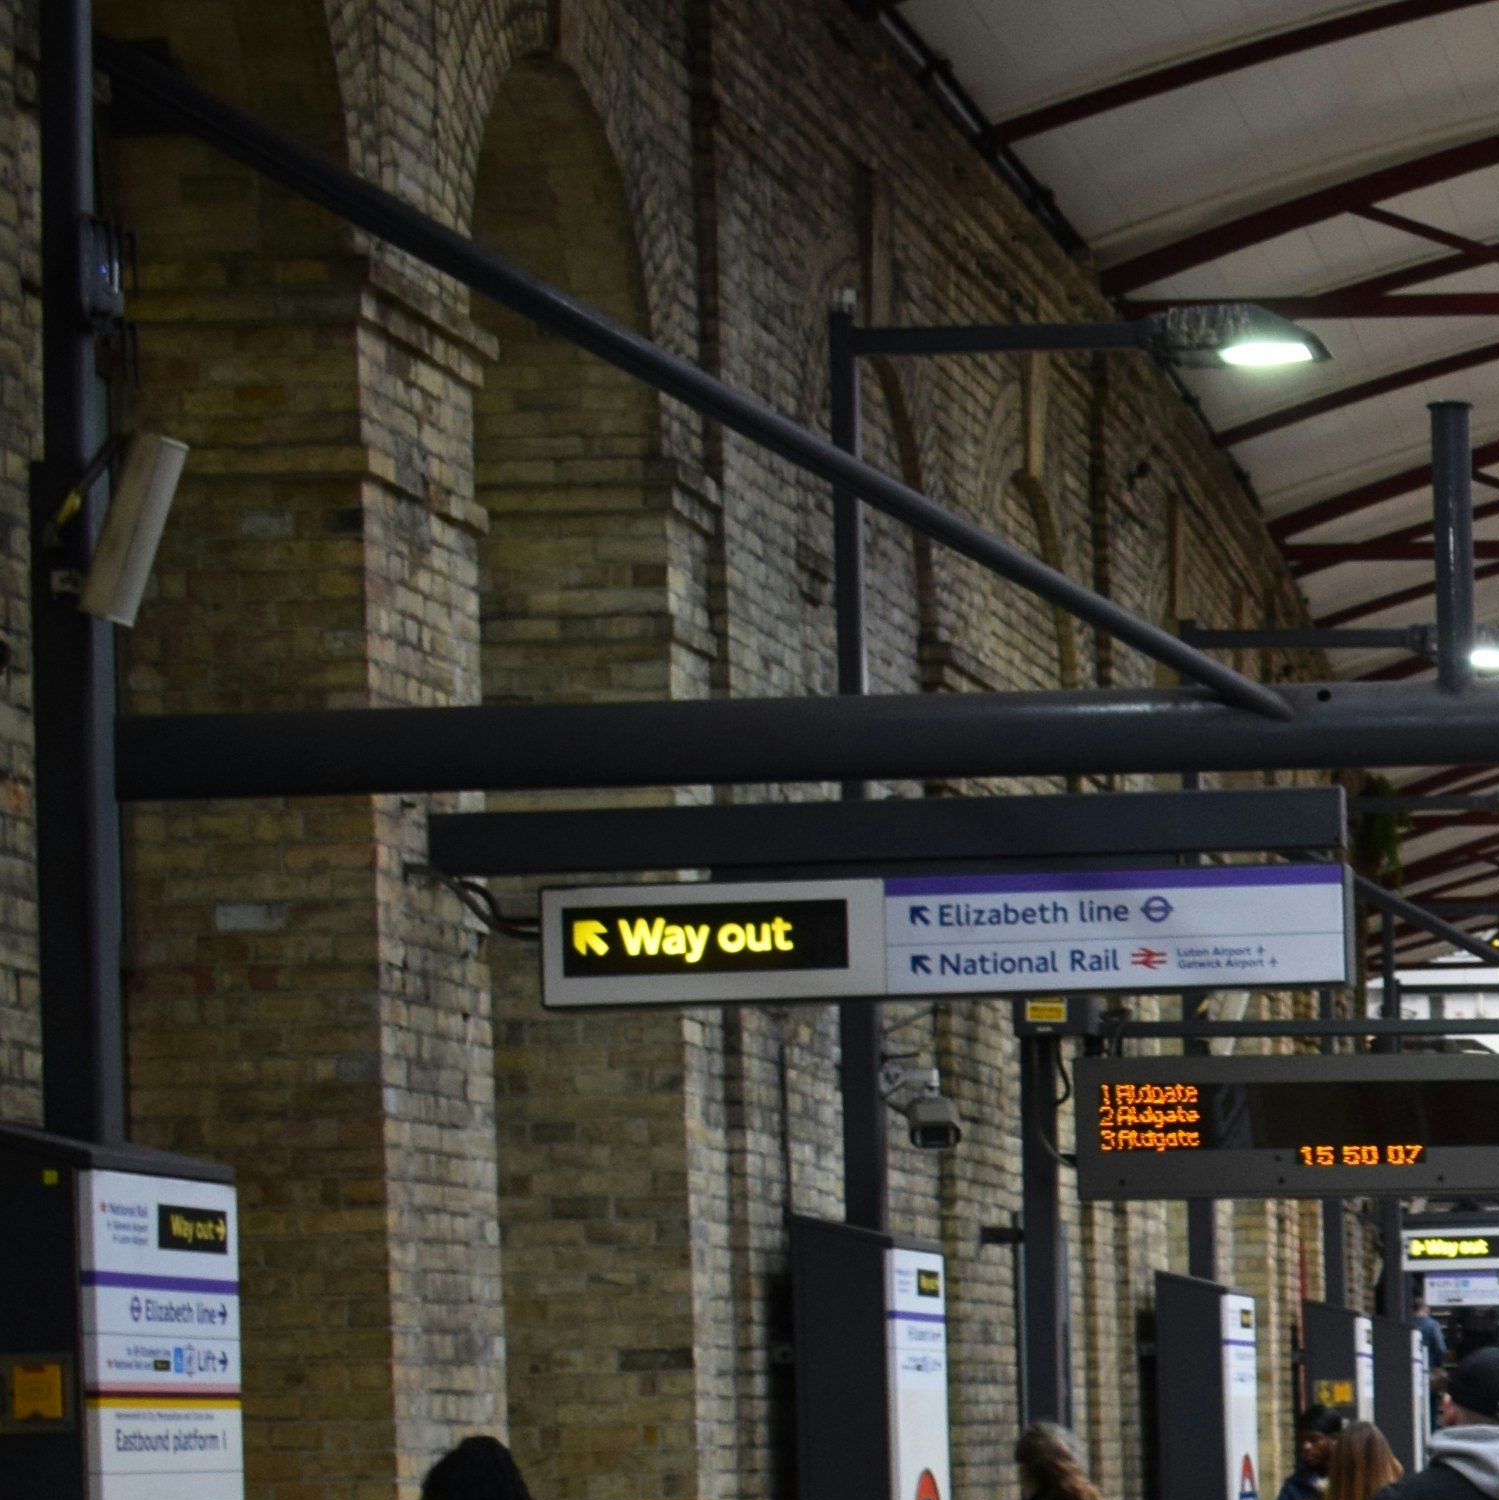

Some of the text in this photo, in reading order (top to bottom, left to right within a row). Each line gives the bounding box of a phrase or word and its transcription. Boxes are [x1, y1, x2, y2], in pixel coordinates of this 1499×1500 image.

[939, 898, 1130, 928] Elizabeth line
[618, 917, 794, 963] Way out
[1212, 946, 1252, 956] Airport
[940, 949, 1120, 976] National Rail
[1178, 958, 1264, 969] Gatwick Airport
[1101, 1083, 1198, 1105] 1 Aldgate
[1099, 1106, 1114, 1126] 2
[1116, 1105, 1200, 1129] Aldgate
[1100, 1130, 1116, 1151] 3
[1118, 1129, 1200, 1152] Aldgate
[170, 1212, 193, 1243] Way
[195, 1217, 214, 1240] out
[145, 1298, 216, 1325] Elizabeth line
[198, 1350, 216, 1372] Lift
[116, 1428, 170, 1452] Eastbound
[173, 1427, 220, 1455] platform
